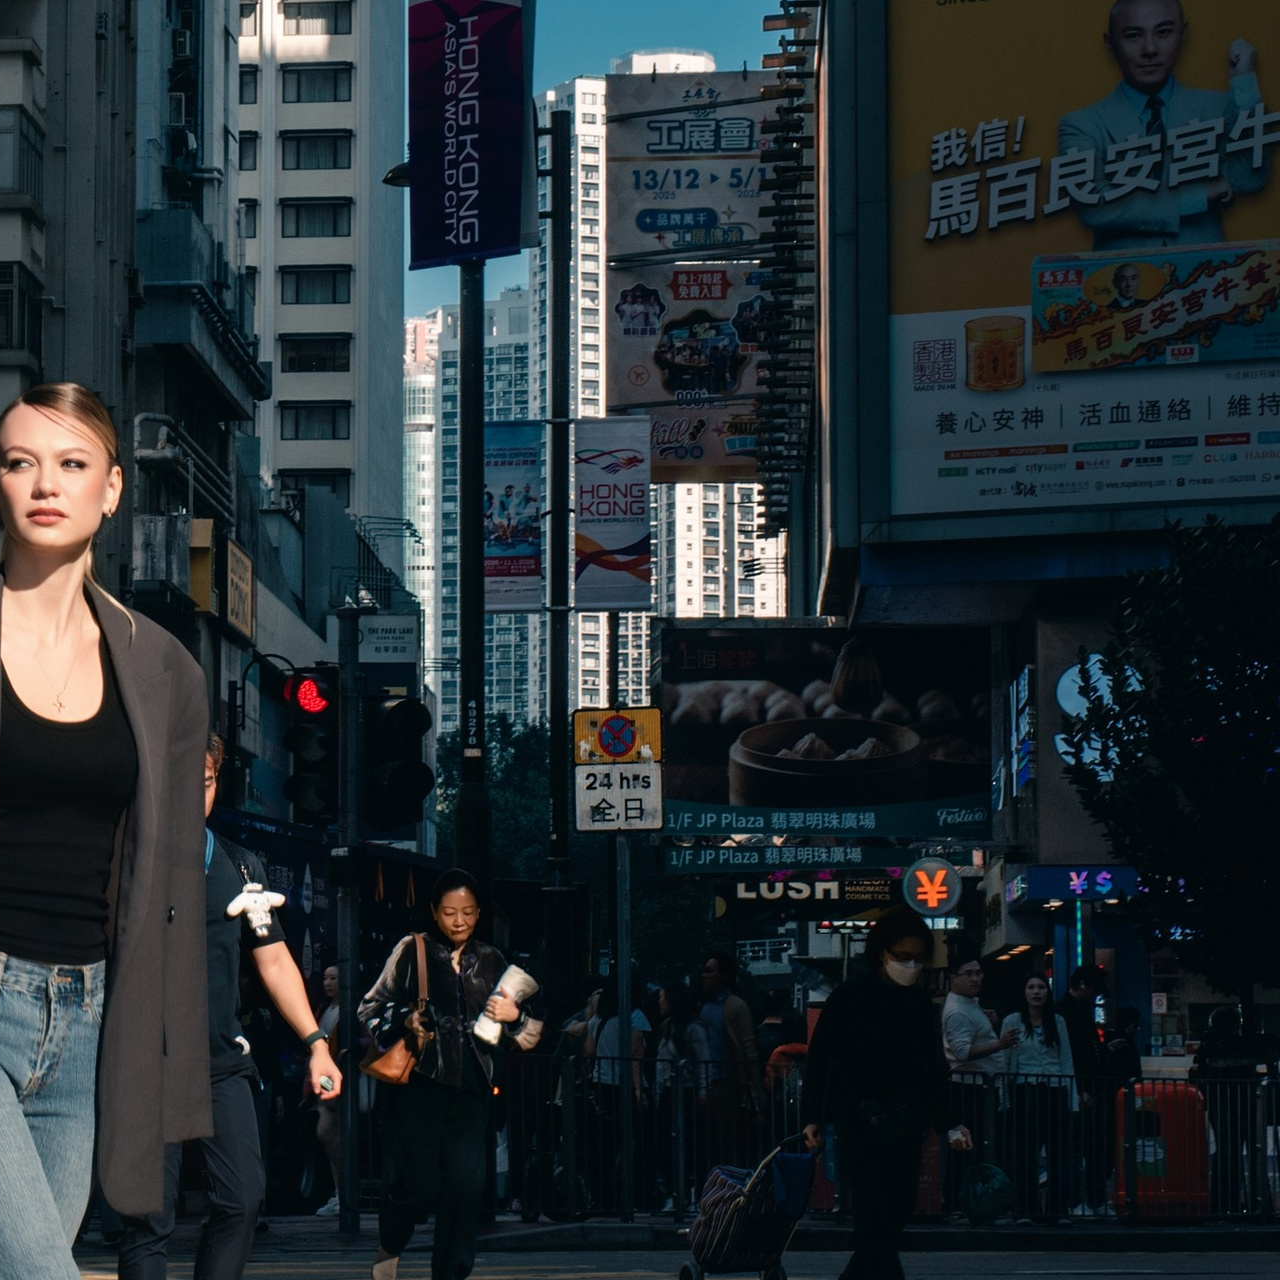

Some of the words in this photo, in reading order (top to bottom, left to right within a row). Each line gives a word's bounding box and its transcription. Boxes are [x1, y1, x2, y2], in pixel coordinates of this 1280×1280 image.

[444, 22, 456, 96] ASIA'S
[458, 16, 479, 125] HONG
[444, 101, 457, 186] WORLD
[648, 119, 752, 152] 工展會
[458, 133, 479, 244] KONG
[633, 170, 699, 190] 13/12
[923, 103, 1280, 241] 馬百良安宮牛
[653, 191, 676, 200] 2025
[444, 191, 457, 244] CITY
[1064, 259, 1280, 365] 馬百良安宮牛黃
[936, 411, 1044, 435] 養心安神
[1079, 399, 1192, 426] 活血通絡
[579, 483, 645, 500] HONG
[579, 500, 645, 517] KONG
[585, 772, 614, 792] 24
[589, 799, 645, 824] 全日
[668, 812, 692, 829] 1/F
[696, 813, 716, 829] JP
[720, 811, 765, 830] Plaza
[770, 811, 876, 830] 翡翠明珠廣場
[671, 851, 693, 867] 1/F
[697, 850, 716, 866] JP
[720, 848, 759, 865] Plaza
[764, 846, 863, 866] 翡翠明珠廣場
